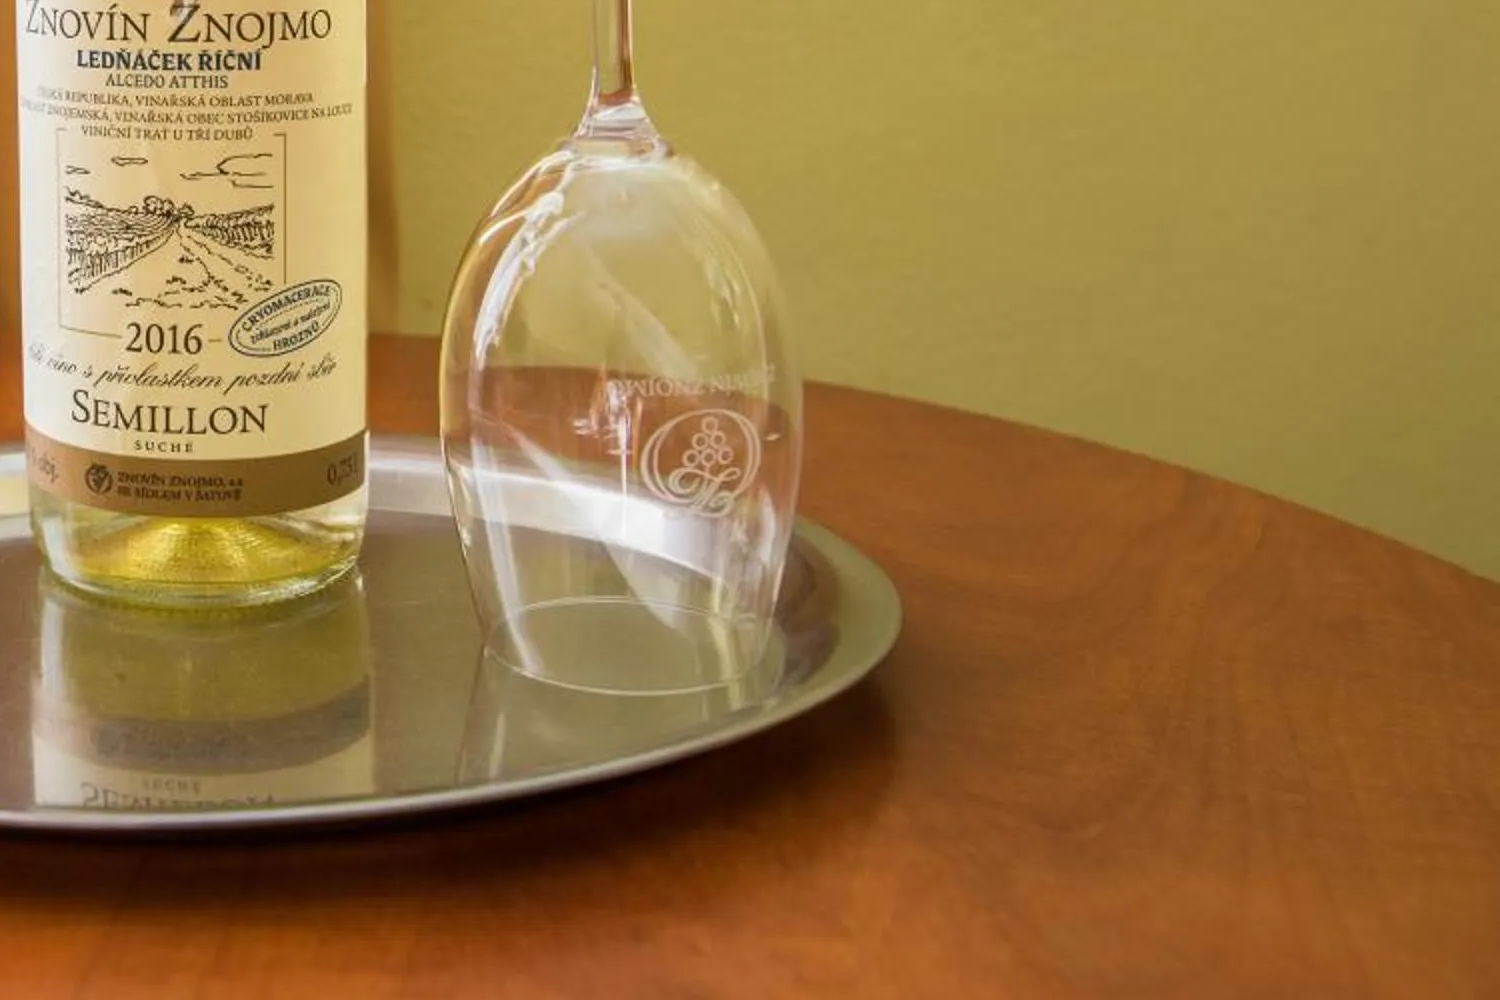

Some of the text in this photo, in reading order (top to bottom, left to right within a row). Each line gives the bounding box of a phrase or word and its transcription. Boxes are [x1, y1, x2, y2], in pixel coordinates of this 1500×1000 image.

[167, 3, 332, 49] ZNOJMO
[77, 48, 263, 71] LEDŇÁČEK ŘÍČNÍ
[105, 73, 229, 89] ALCEDO ATTHIS
[208, 95, 262, 108] OBLAST
[264, 92, 314, 106] MORAVA
[173, 129, 183, 141] U
[124, 322, 203, 355] 2016
[71, 388, 270, 435] SEMILLON
